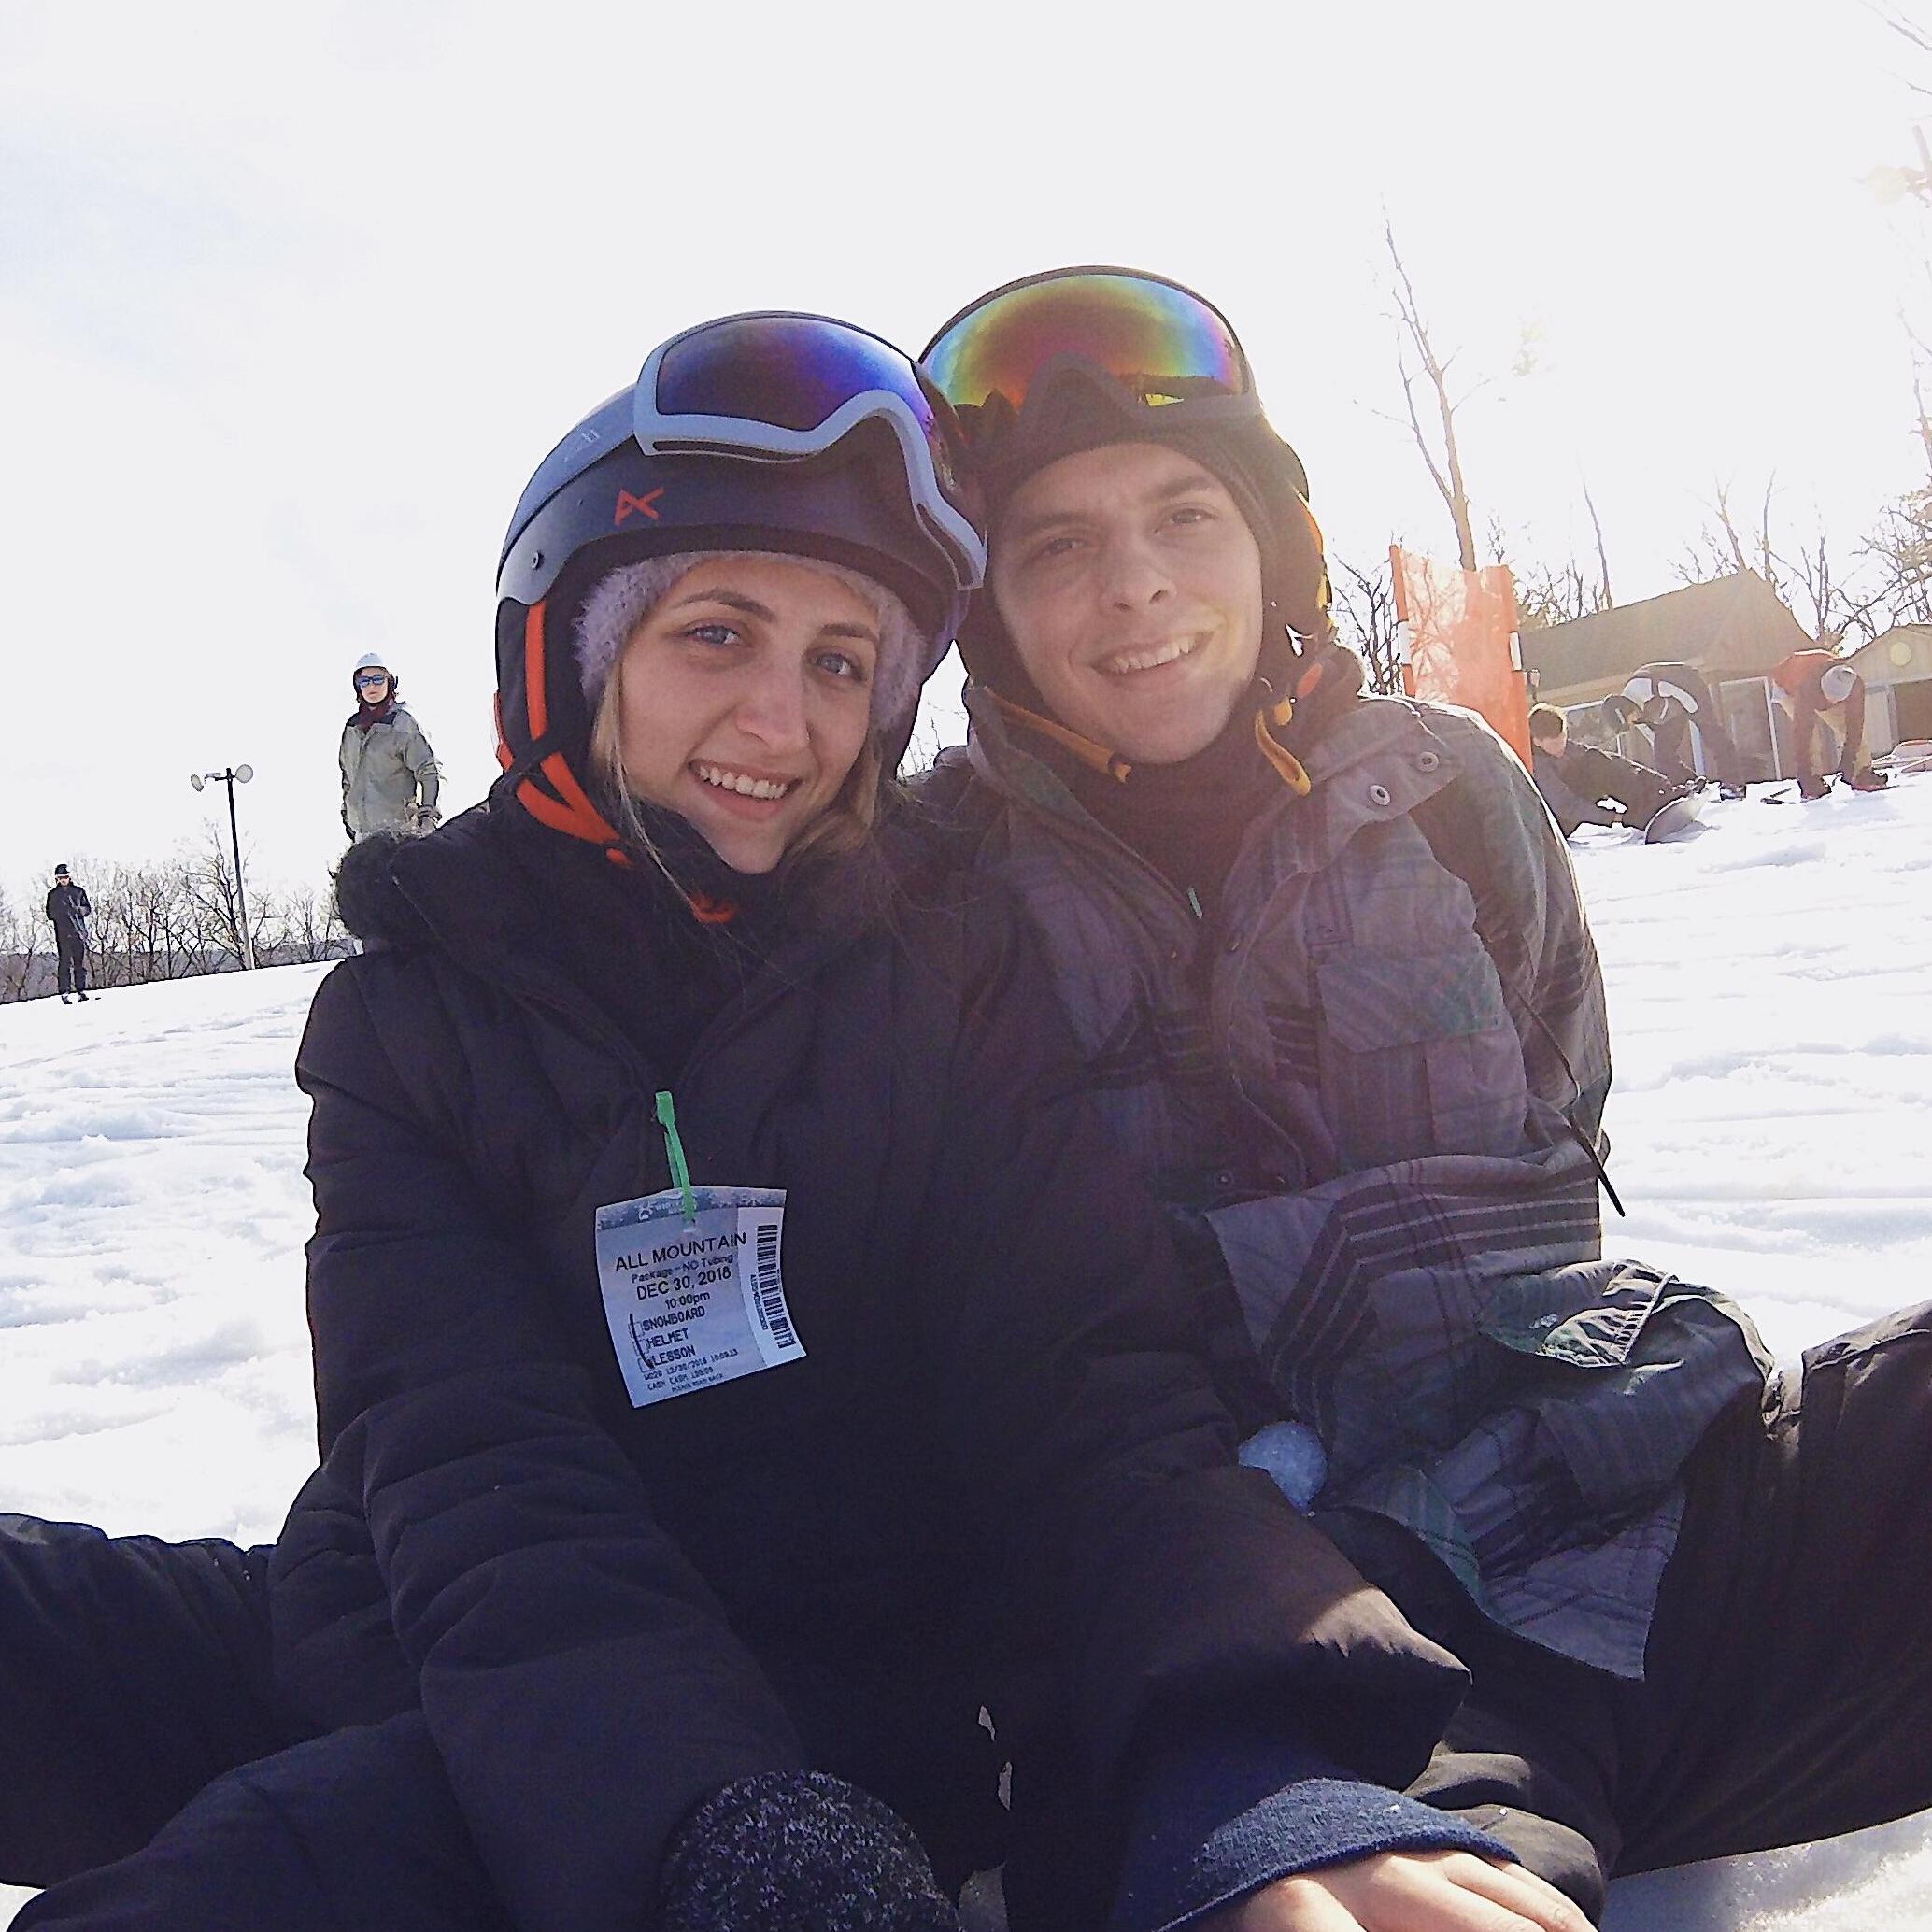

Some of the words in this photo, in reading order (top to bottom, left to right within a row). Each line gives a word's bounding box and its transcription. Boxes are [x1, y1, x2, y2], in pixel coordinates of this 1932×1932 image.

[615, 1253, 648, 1271] ALL
[653, 1232, 746, 1264] MOUNTAIN
[636, 1280, 669, 1300] DEC
[674, 1275, 695, 1290] 30,
[698, 1266, 732, 1286] 2018
[665, 1291, 710, 1310] 10:00pm
[642, 1305, 706, 1331] SNOWBOARD
[647, 1328, 689, 1348] HELMET
[652, 1345, 696, 1366] LESSON
